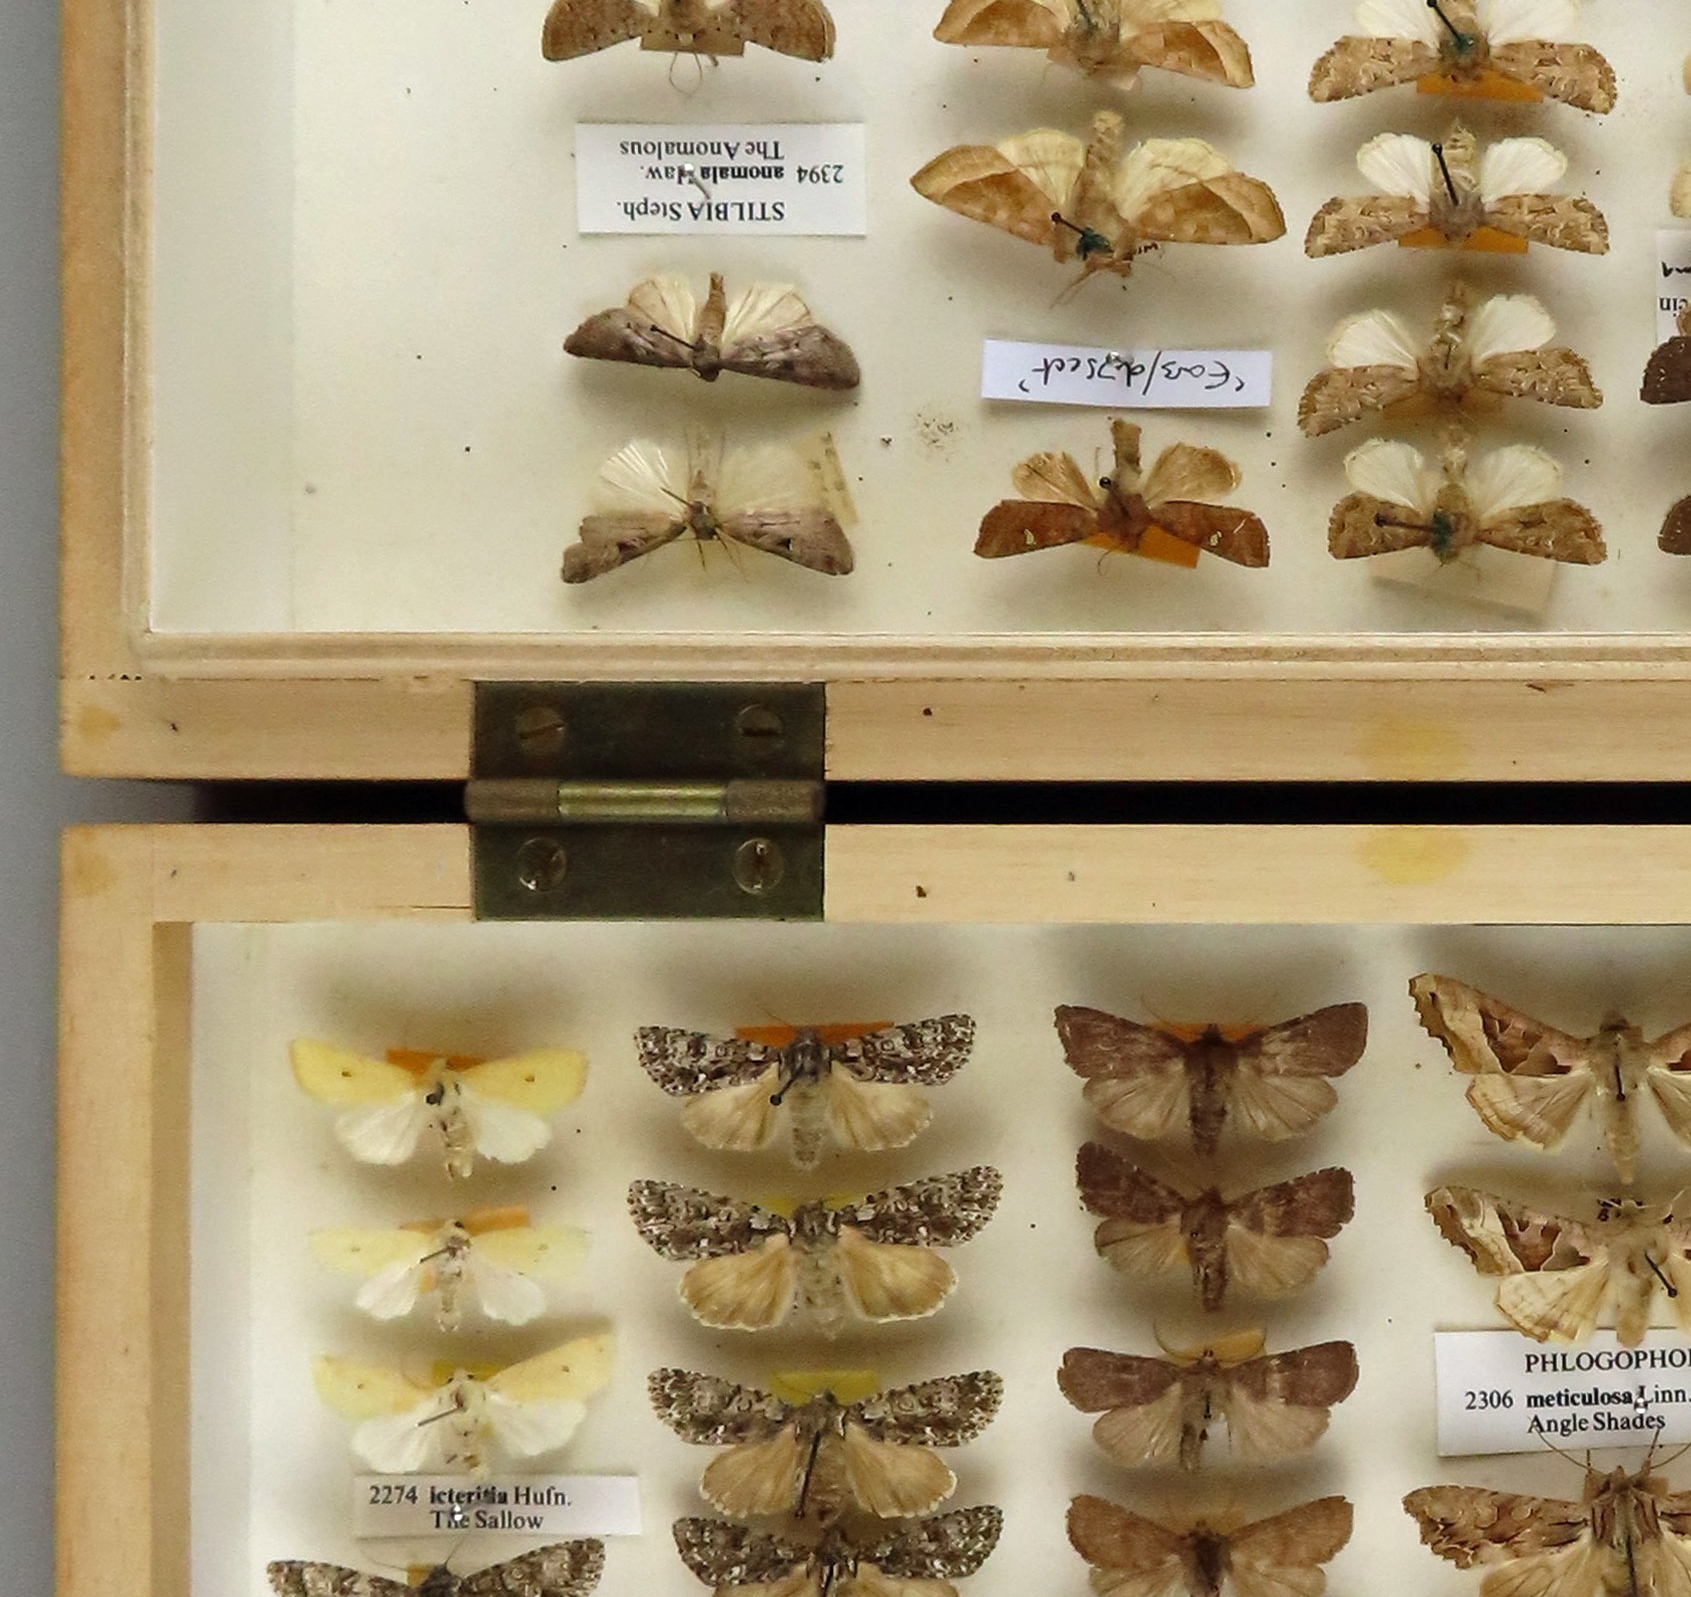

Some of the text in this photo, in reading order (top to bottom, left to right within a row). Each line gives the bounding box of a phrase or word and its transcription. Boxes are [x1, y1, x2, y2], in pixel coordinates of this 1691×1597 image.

[620, 141, 783, 160] The Anomalous
[701, 166, 784, 183] anomala
[796, 164, 844, 183] 2394
[617, 197, 785, 220] STILBIA Steph.
[1464, 1390, 1513, 1411] 2306
[1526, 1388, 1633, 1409] meticulosa
[1527, 1410, 1666, 1437] Angle Shades
[369, 1486, 418, 1505] 2274
[514, 1486, 571, 1507] Hufn.
[475, 1511, 544, 1530] Sallow
